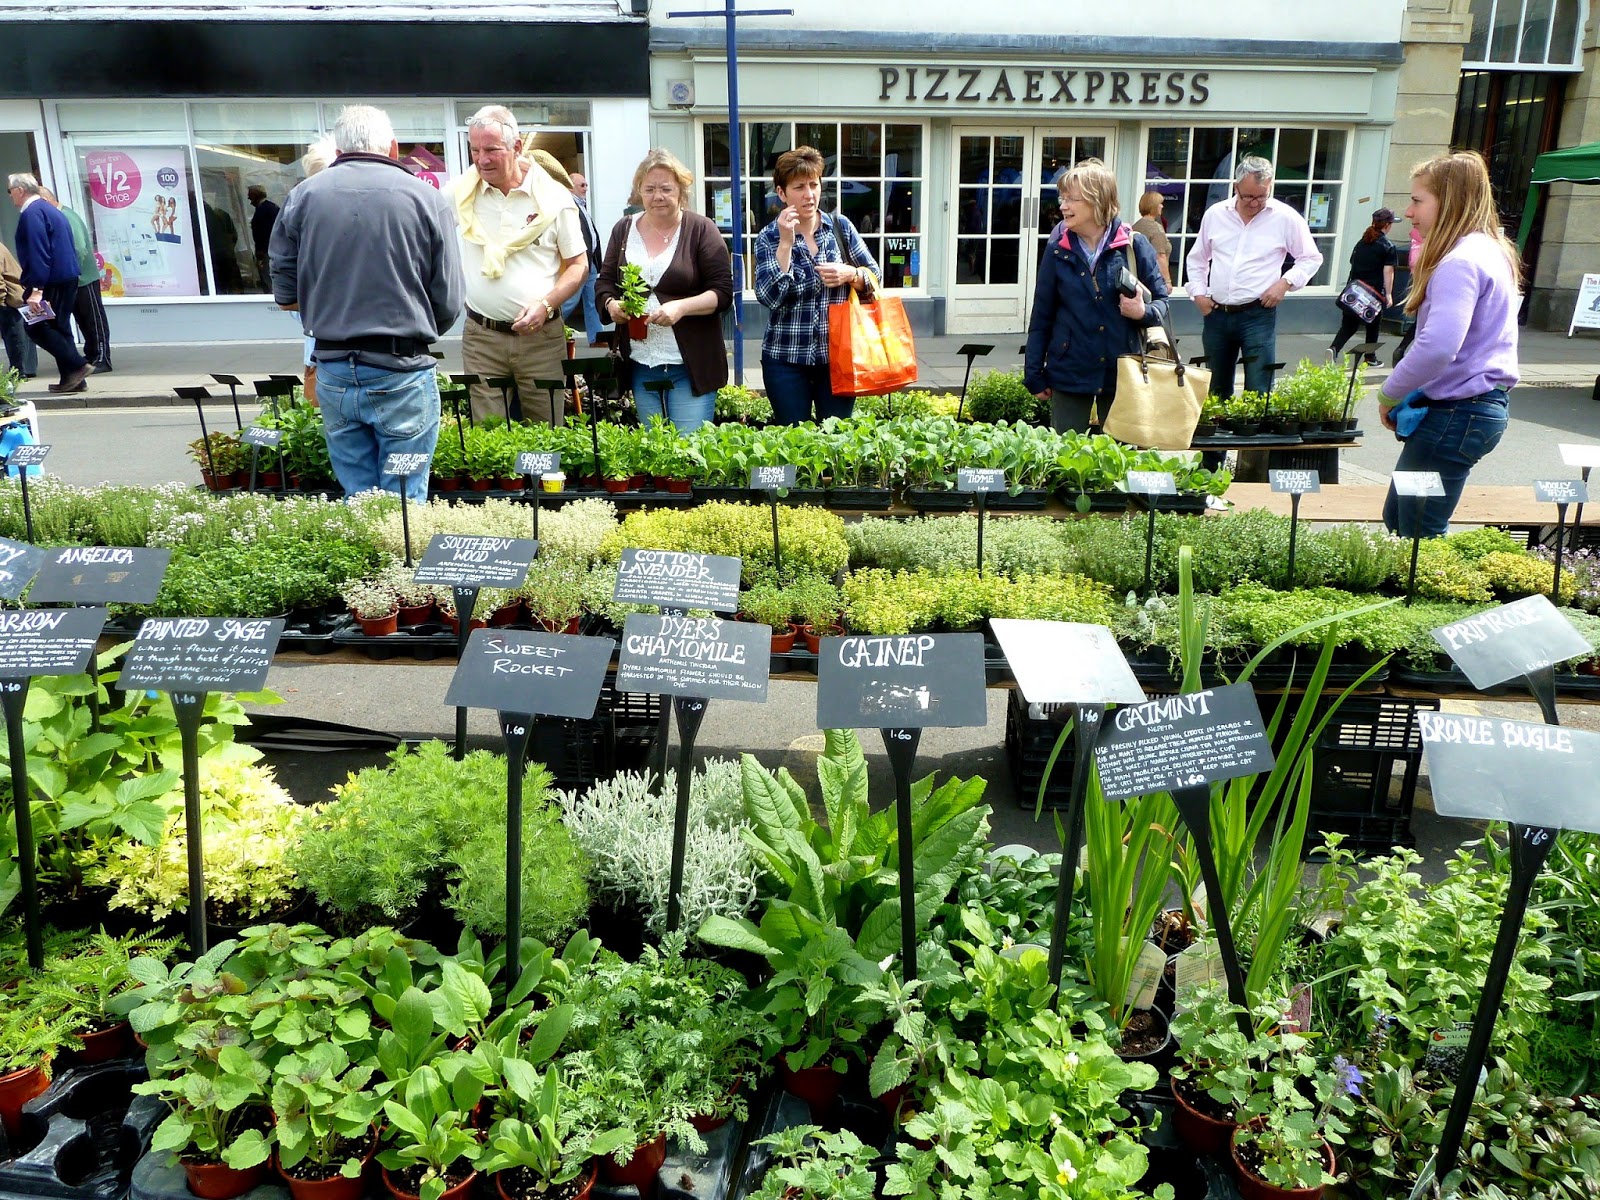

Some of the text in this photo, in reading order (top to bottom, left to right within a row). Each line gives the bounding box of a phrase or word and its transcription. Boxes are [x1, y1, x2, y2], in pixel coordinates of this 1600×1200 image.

[878, 67, 1210, 104] PIZZAEXPRESS
[93, 163, 131, 194] 1/2
[160, 173, 176, 183] 100
[104, 192, 130, 204] Price
[887, 238, 917, 251] Wi-Fi
[249, 427, 280, 439] THYME
[520, 452, 553, 462] ORANGE
[393, 462, 420, 471] THYME
[521, 460, 552, 470] THYME
[759, 466, 785, 475] LEMON
[758, 474, 785, 483] THYME
[966, 475, 995, 484] THYME
[1275, 470, 1312, 481] GOLDEN
[1275, 479, 1313, 489] THYME
[1537, 480, 1572, 490] WOOLLY
[1543, 488, 1579, 498] THYME
[438, 536, 514, 552] SOUTHERN
[56, 548, 134, 565] ANGELICA
[453, 549, 488, 562] WOOD
[635, 550, 707, 568] COTTON
[619, 560, 714, 581] LAVENDER
[458, 588, 472, 596] 3.50
[664, 607, 682, 616] 3.50
[0, 612, 68, 632] ARROW
[659, 616, 723, 640] DYERS
[1441, 602, 1542, 650] PRIMROSE
[136, 619, 271, 641] PAINTED SAGE
[186, 643, 223, 653] flower
[229, 644, 238, 652] it
[240, 645, 267, 655] looks
[484, 640, 566, 658] SWEET
[627, 634, 745, 664] CHAMOMILE
[839, 635, 935, 668] CATNEP
[148, 654, 180, 664] though
[197, 654, 219, 662] host
[222, 653, 234, 665] of
[211, 666, 240, 677] wings
[492, 659, 573, 677] ROCKET
[622, 663, 641, 671] DYERS
[680, 669, 705, 677] FLOWERS
[130, 673, 163, 684] playing
[179, 673, 191, 681] the
[197, 675, 230, 684] garden
[680, 676, 707, 684] SUMMER
[174, 693, 196, 704] 1.60
[681, 701, 702, 711] 1.60
[1115, 690, 1214, 731] CATMINT
[1080, 708, 1098, 722] 1.60
[506, 724, 525, 735] 1.60
[1147, 724, 1174, 733] NEPETA
[1417, 712, 1574, 753] BRONZE BUGLE
[890, 730, 912, 740] 1.60
[1095, 746, 1108, 755] USE
[1111, 741, 1136, 751] FRESHLY
[1138, 737, 1158, 746] PICKED
[1161, 733, 1183, 742] YOUNG
[1216, 722, 1241, 731] SALADS
[1097, 760, 1122, 770] CATMINT
[1220, 760, 1237, 769] YOUR
[1240, 757, 1252, 765] CAT
[1133, 767, 1160, 777] PROBLEM
[1176, 774, 1207, 788] 1.60
[1523, 827, 1549, 846] 1.60
